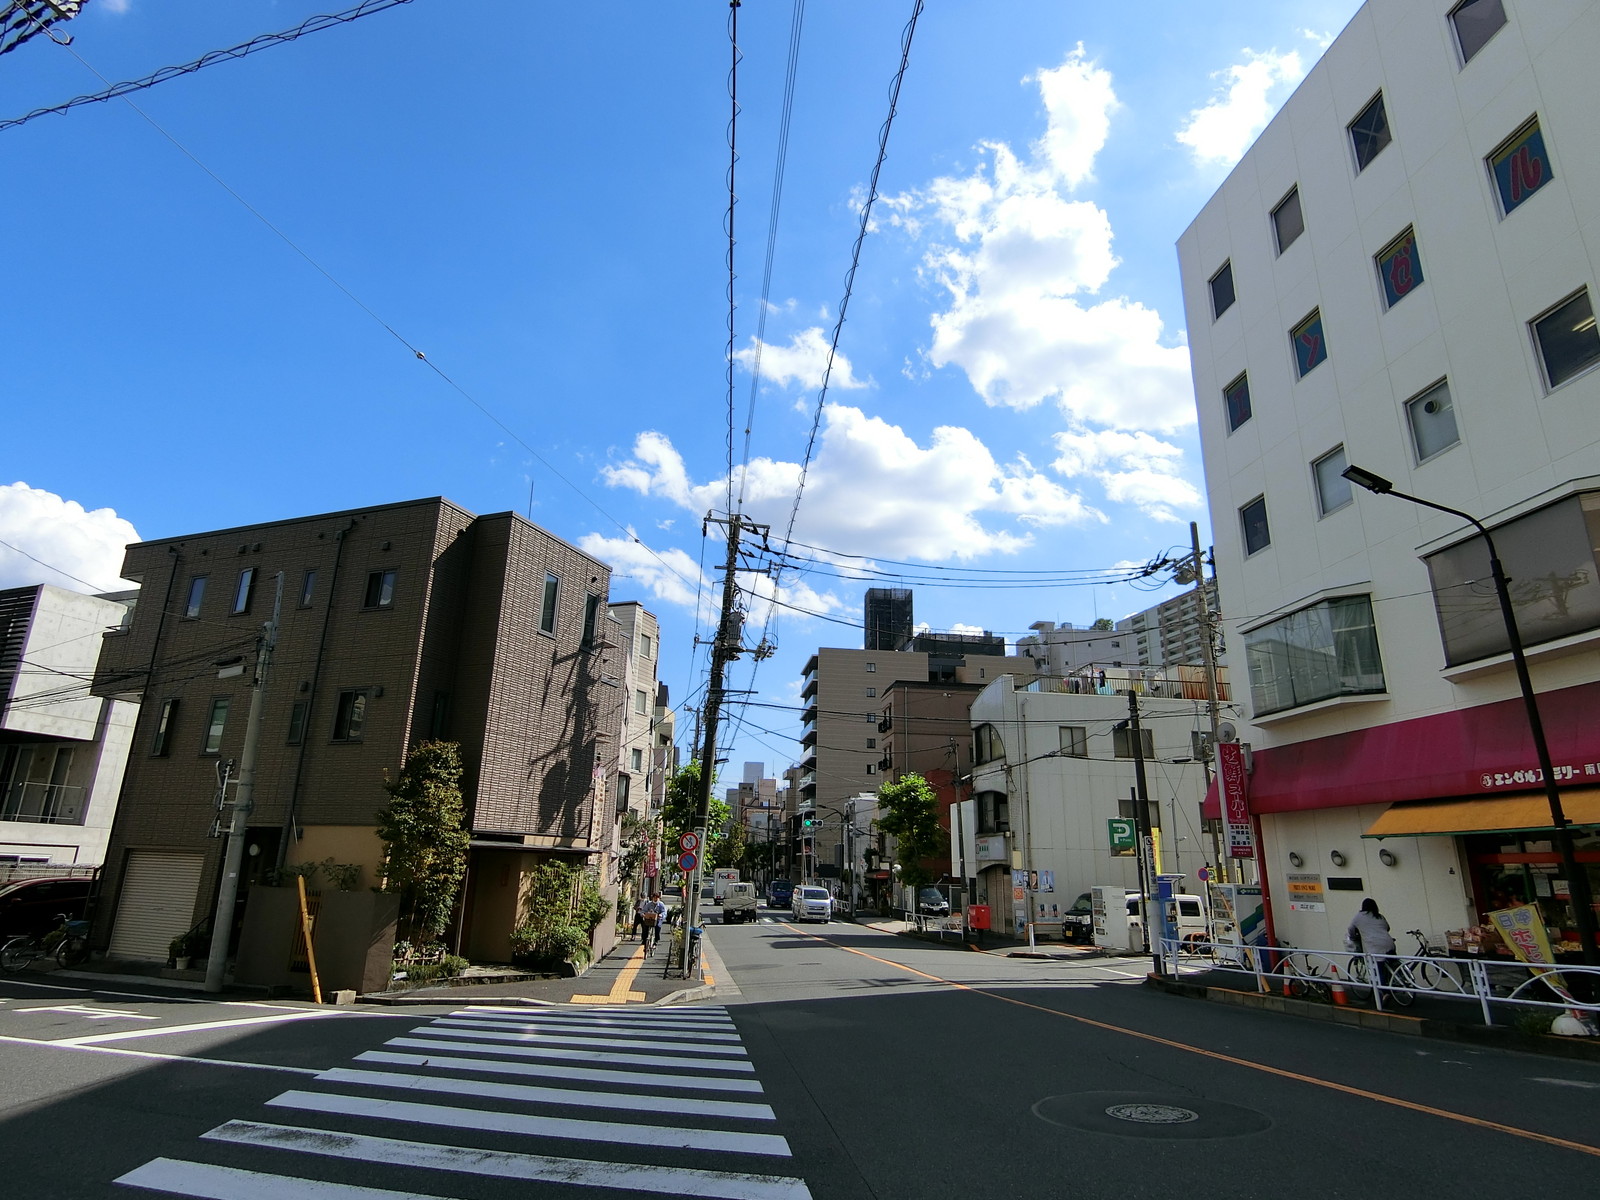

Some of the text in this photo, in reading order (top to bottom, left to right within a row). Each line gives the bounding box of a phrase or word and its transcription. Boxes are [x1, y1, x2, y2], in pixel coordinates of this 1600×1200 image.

[1493, 765, 1580, 786] エンゼルフミリー
[1112, 823, 1131, 844] P
[1497, 908, 1533, 930] 日本
